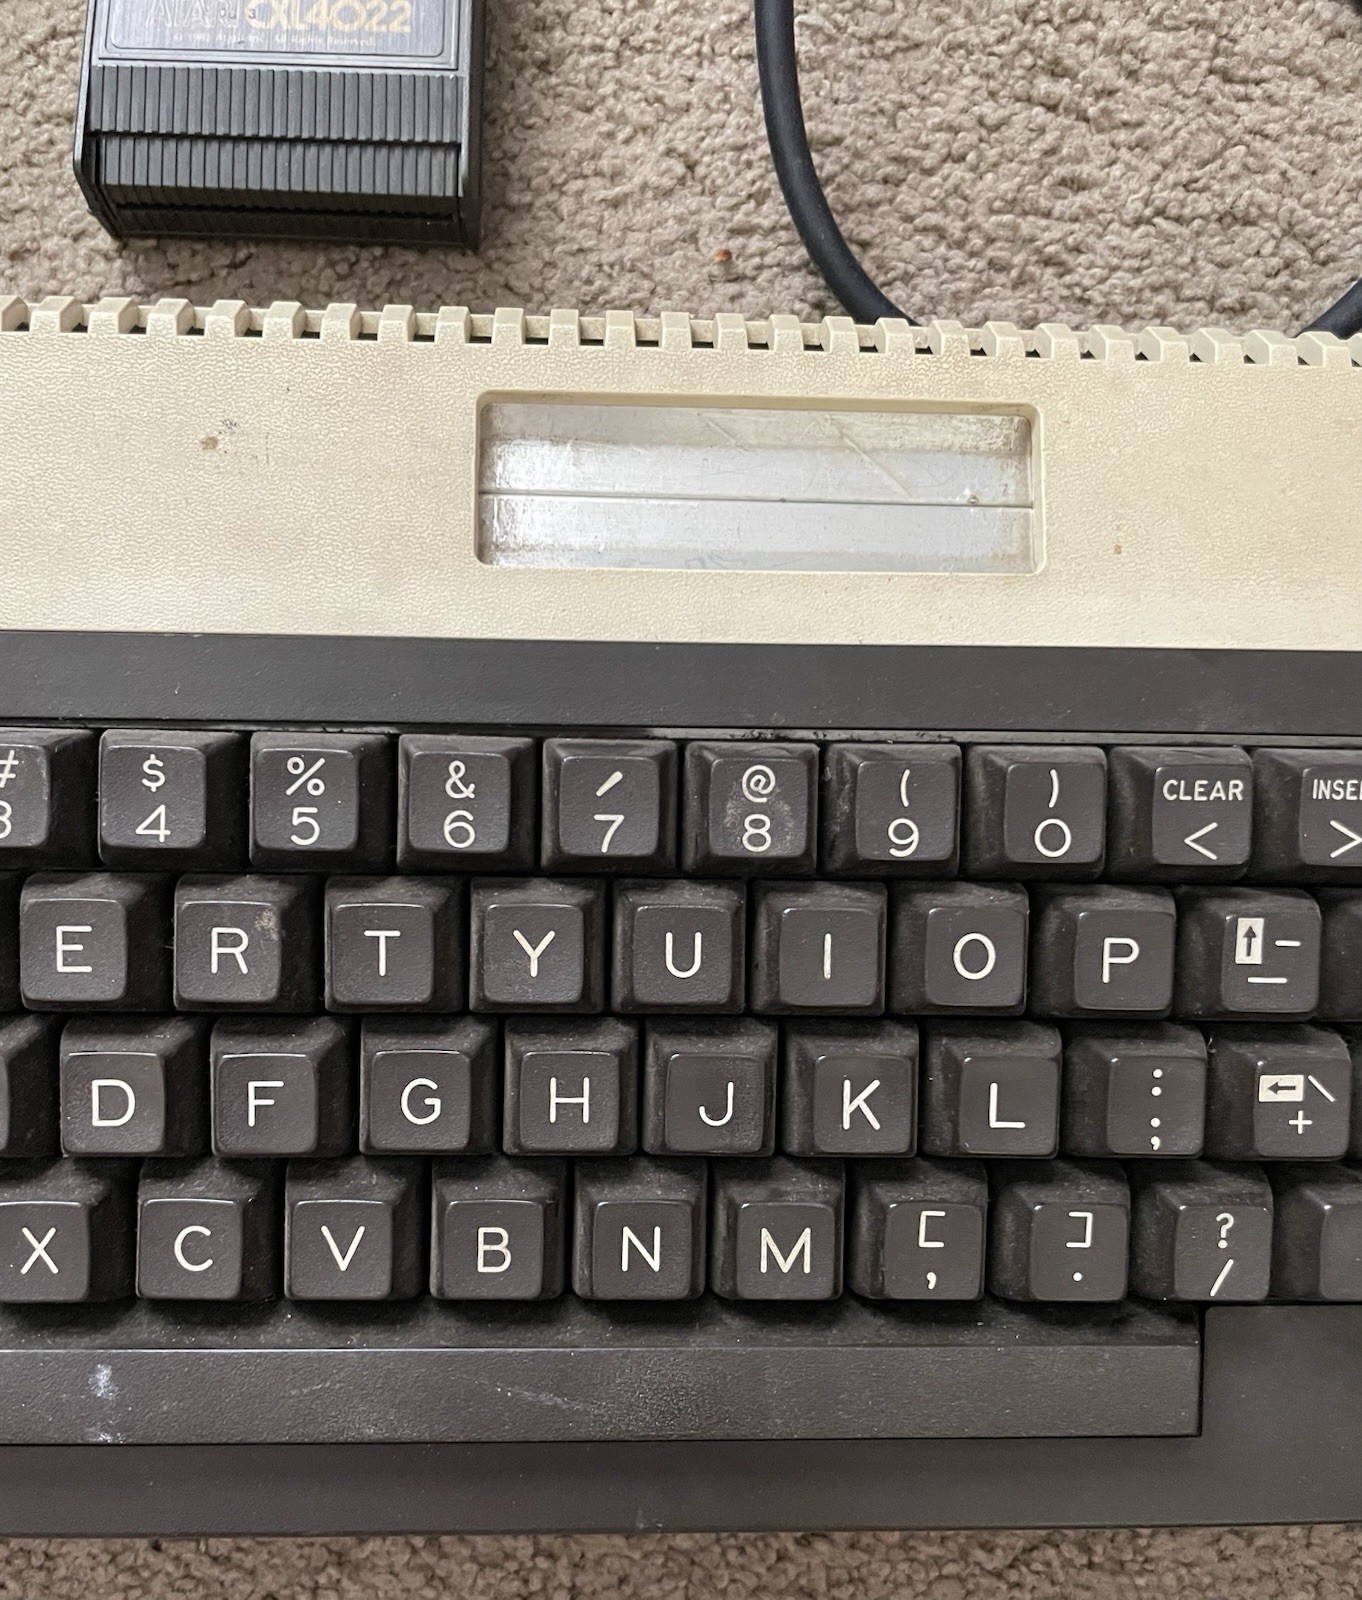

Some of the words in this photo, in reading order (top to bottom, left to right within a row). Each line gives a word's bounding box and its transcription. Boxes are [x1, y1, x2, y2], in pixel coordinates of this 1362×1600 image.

[244, 0, 411, 33] CXL4022
[141, 753, 166, 793] $
[285, 756, 326, 797] %
[445, 760, 476, 799] &
[741, 764, 776, 803] @
[1162, 779, 1244, 801] CLEAR
[1312, 778, 1362, 801] INSE
[135, 804, 172, 843] 4
[290, 806, 321, 846] 5
[443, 809, 476, 849] 6
[593, 814, 625, 853] 7
[742, 813, 772, 853] 8
[888, 818, 920, 858] 9
[55, 925, 93, 973] E
[210, 926, 249, 975] R
[363, 930, 401, 977] T
[512, 929, 556, 978] Y
[665, 931, 702, 979] U
[823, 933, 832, 979] I
[953, 932, 996, 980] O
[1102, 937, 1140, 984] P
[91, 1078, 136, 1127] D
[247, 1080, 285, 1127] F
[401, 1077, 442, 1125] G
[549, 1076, 590, 1124] H
[698, 1081, 734, 1127] J
[842, 1079, 881, 1131] K
[989, 1082, 1026, 1129] L
[20, 1227, 59, 1275] X
[174, 1225, 214, 1272] C
[320, 1225, 366, 1272] V
[477, 1226, 512, 1273] B
[621, 1226, 661, 1272] N
[760, 1227, 811, 1274] M
[1215, 1212, 1235, 1249] ?
